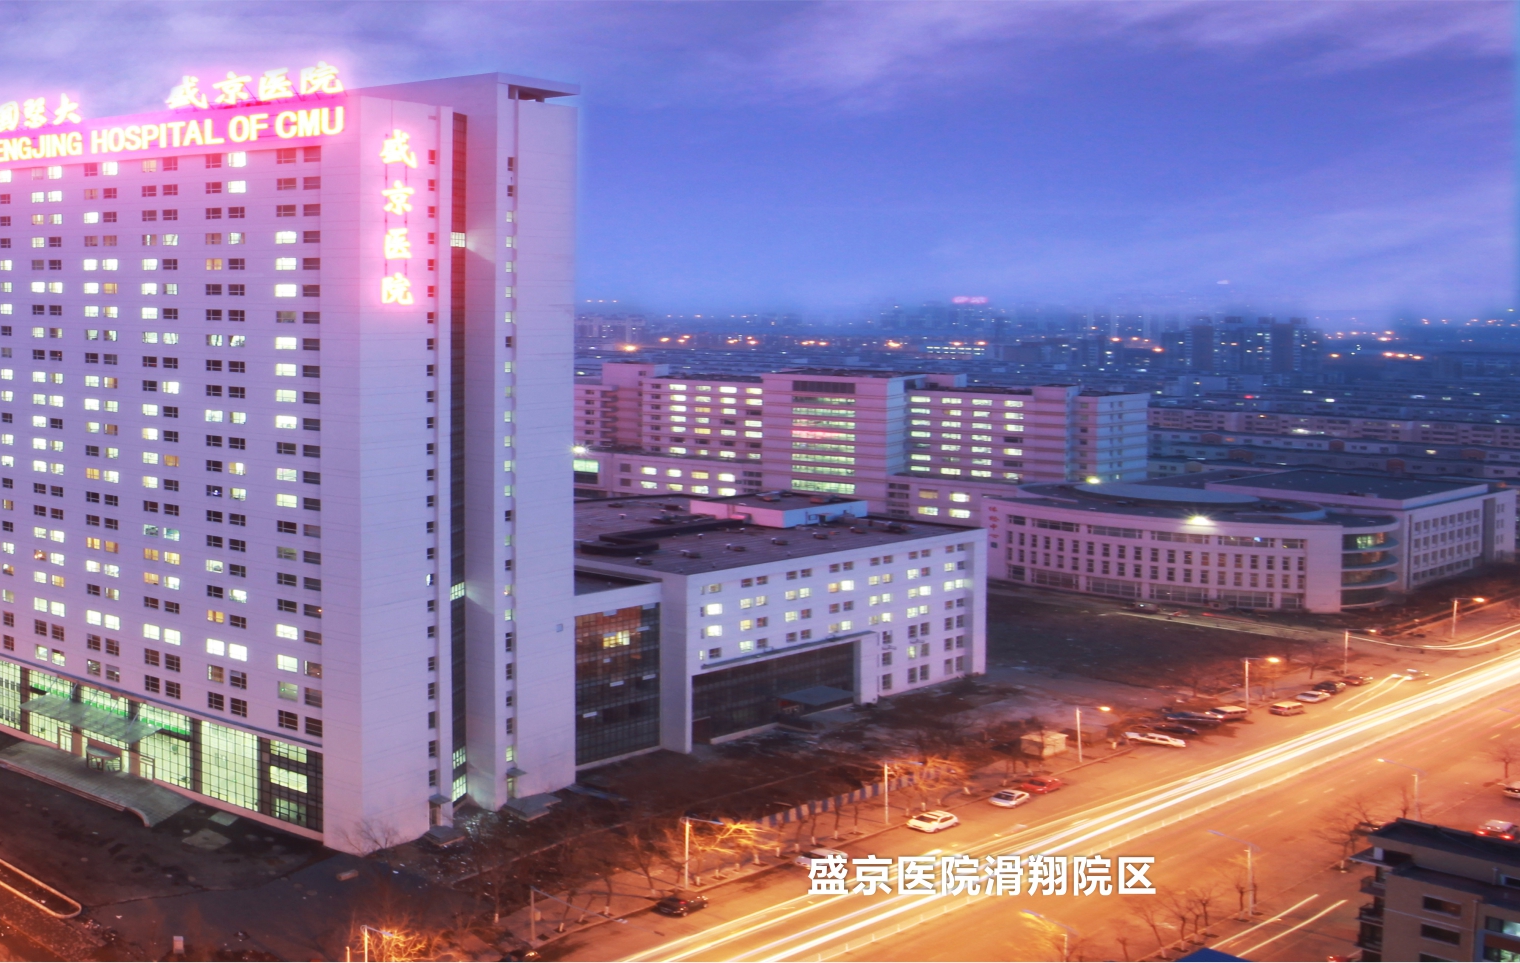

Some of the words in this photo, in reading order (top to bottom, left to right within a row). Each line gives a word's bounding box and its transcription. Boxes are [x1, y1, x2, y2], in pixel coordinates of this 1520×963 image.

[165, 60, 345, 110] 盛京医院
[90, 118, 225, 154] HOSPITAL
[228, 113, 269, 143] OF
[275, 106, 344, 139] CMU
[379, 128, 418, 305] 盛京医院
